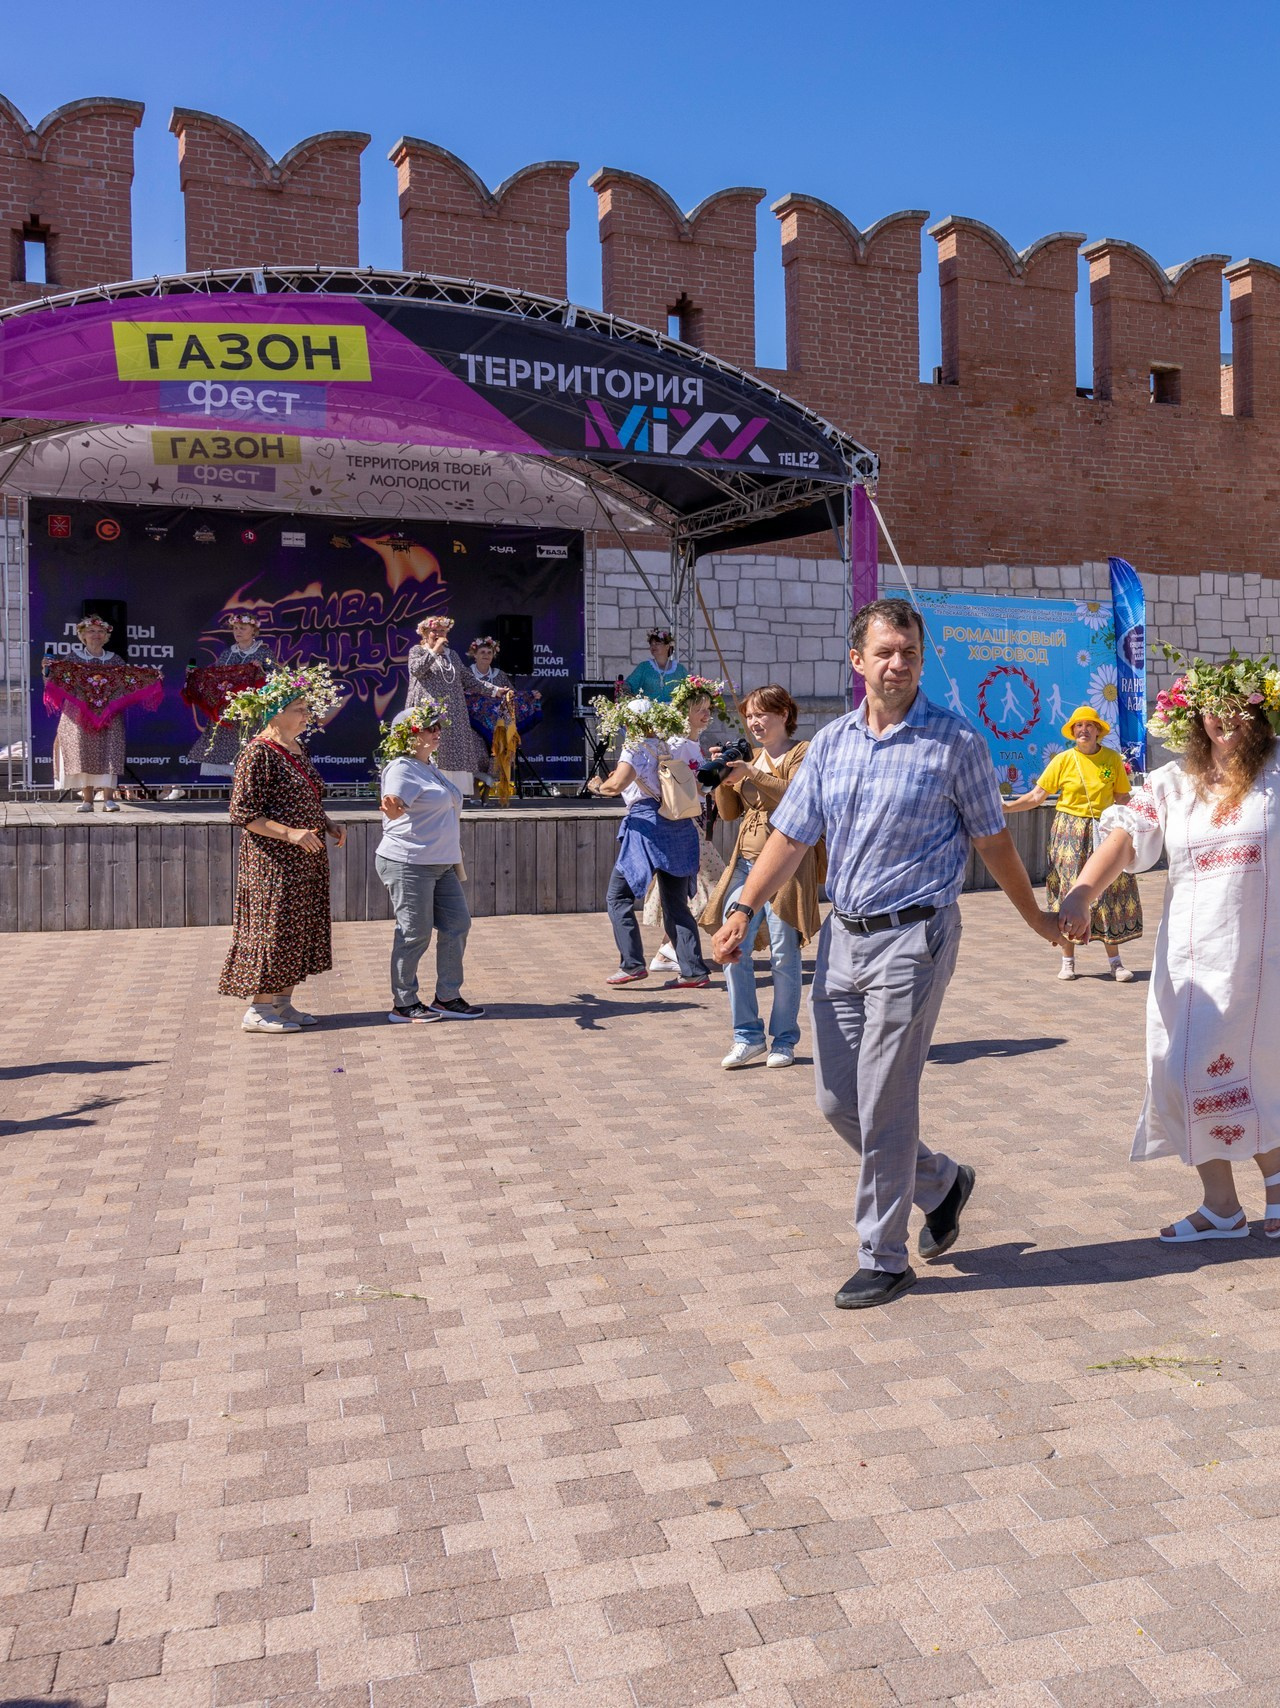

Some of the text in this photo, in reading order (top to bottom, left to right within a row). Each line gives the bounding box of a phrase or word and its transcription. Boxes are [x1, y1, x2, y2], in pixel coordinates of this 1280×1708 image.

[146, 333, 342, 371] ГАЗОН
[459, 353, 704, 406] ТЕРРИТОРИЯ
[187, 380, 300, 415] фест
[170, 437, 285, 459] ГАЗОН
[346, 454, 492, 477] ТЕРРИТОРИЯ ТВОЕЙ
[778, 452, 820, 469] TELE2
[193, 464, 260, 485] фест
[370, 474, 470, 492] МОЛОДОСТИ
[943, 625, 1067, 648] РОМАШКОВЫЙ
[968, 644, 1049, 665] ХОРОВОД
[126, 756, 171, 765] воркаут
[545, 755, 583, 763] самокат
[1000, 751, 1024, 760] ТУЛА
